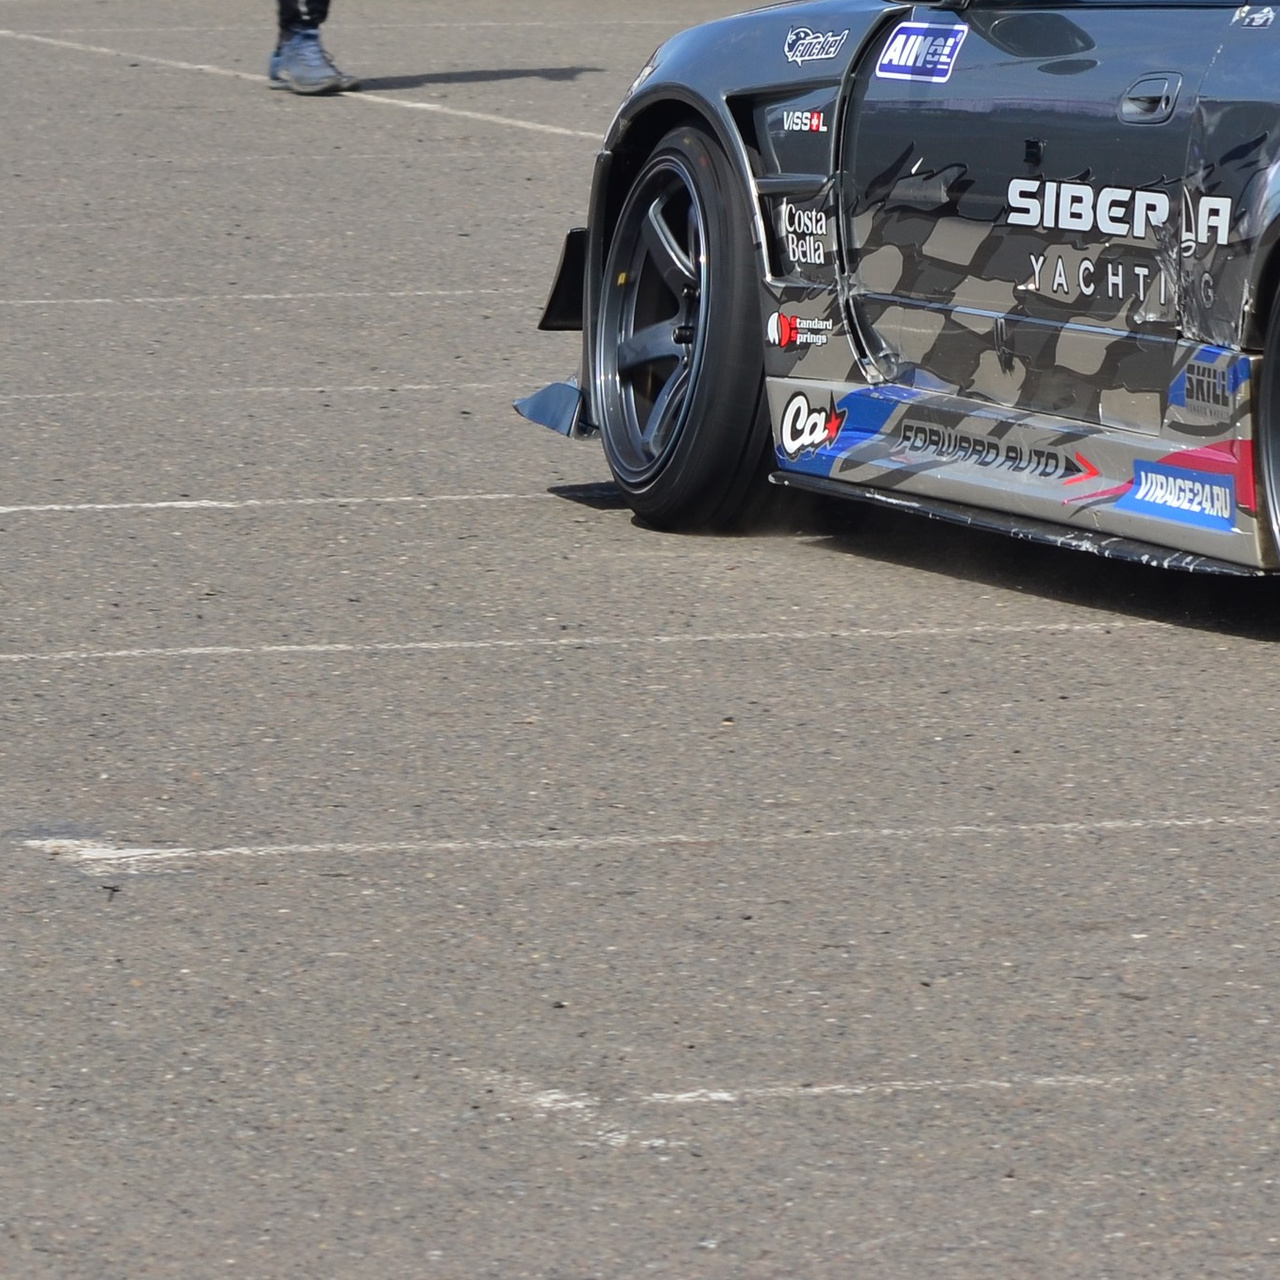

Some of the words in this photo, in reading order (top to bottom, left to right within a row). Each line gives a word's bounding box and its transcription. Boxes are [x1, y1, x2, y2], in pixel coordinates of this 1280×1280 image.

[785, 204, 827, 235] Costa
[789, 233, 825, 265] Bella
[1030, 254, 1215, 308] YACHTIG
[790, 316, 832, 330] Standard
[790, 330, 828, 347] Springs
[1186, 363, 1229, 407] SKILL
[898, 424, 1002, 467] FORWARD
[1002, 445, 1060, 478] AUTO
[1137, 470, 1231, 519] VIRAGE24.RU
